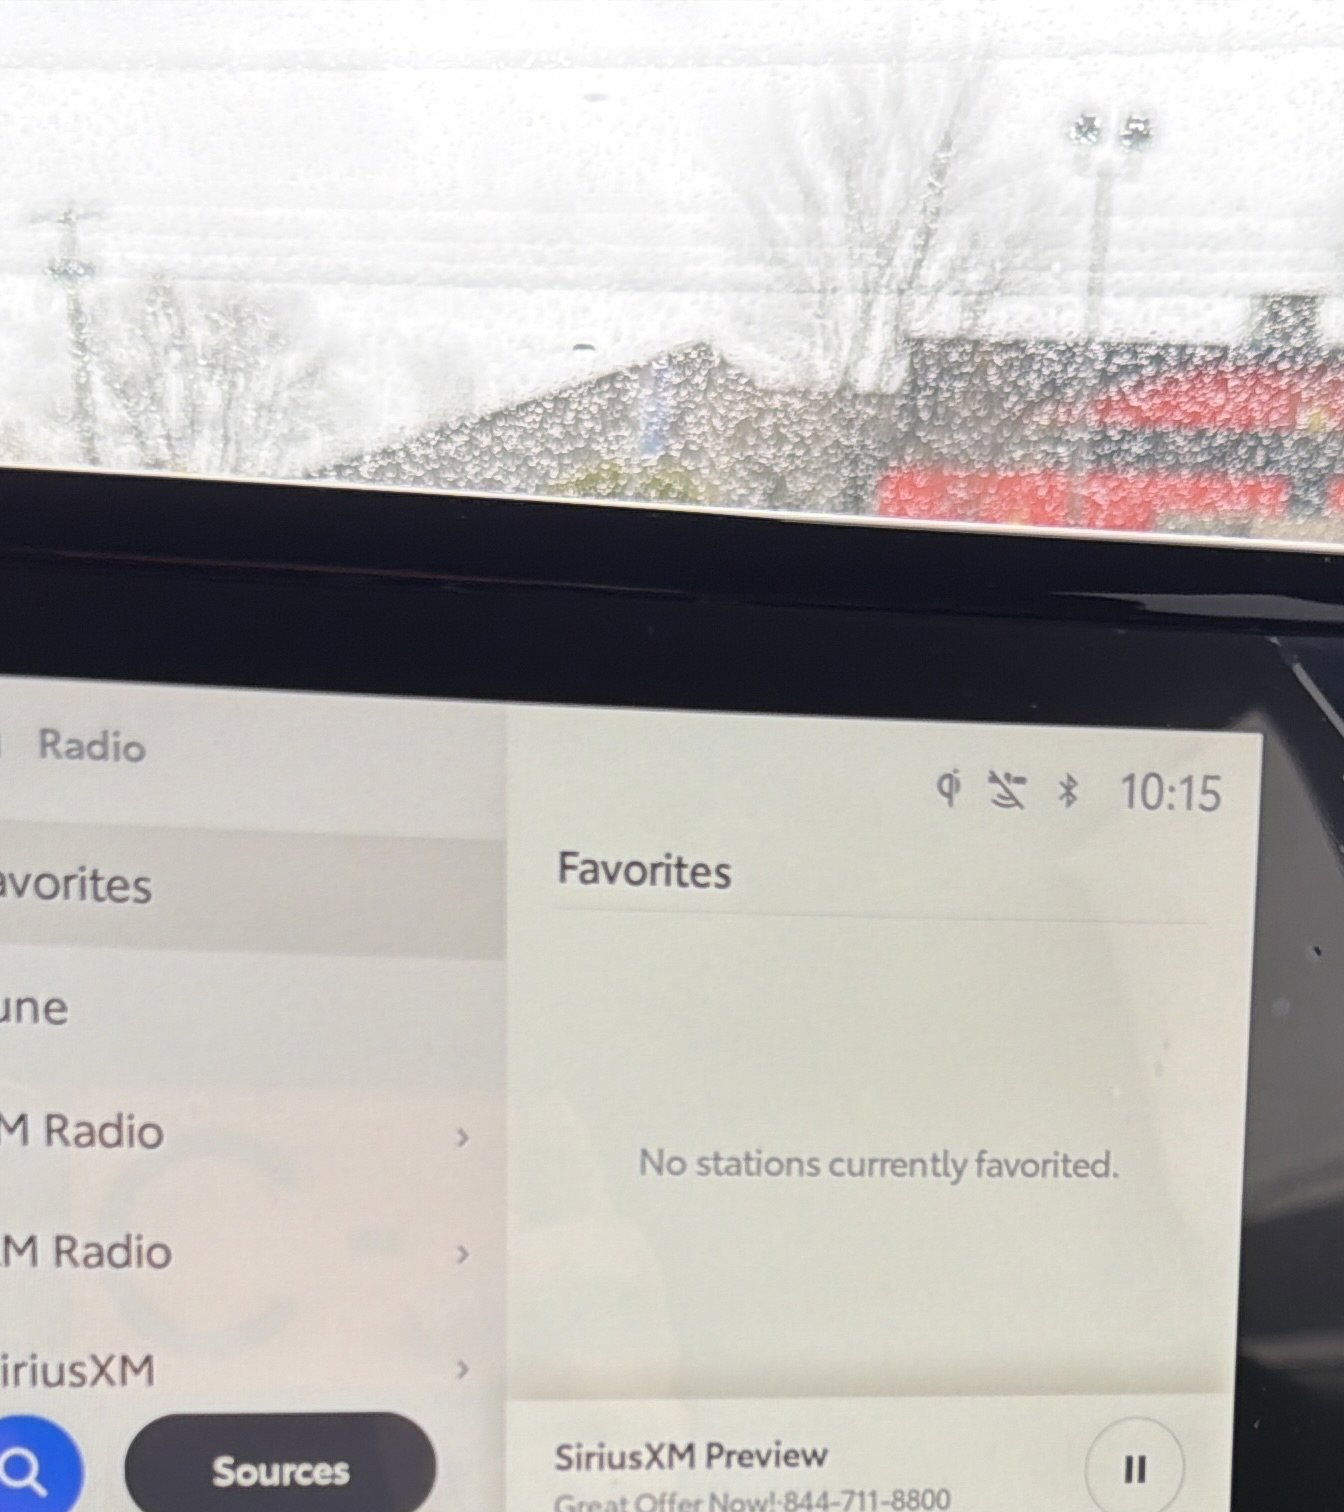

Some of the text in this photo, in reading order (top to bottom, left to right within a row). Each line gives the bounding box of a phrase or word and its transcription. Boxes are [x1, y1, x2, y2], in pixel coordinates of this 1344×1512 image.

[38, 727, 147, 764] Radio
[1120, 771, 1223, 813] 10:15
[558, 850, 733, 891] Favorites
[45, 1112, 166, 1151] Radio
[639, 1147, 1120, 1186] No stations currently favorited.
[54, 1233, 173, 1272] Radio
[211, 1454, 351, 1489] Sources
[554, 1440, 830, 1474] SiriusXM Preview
